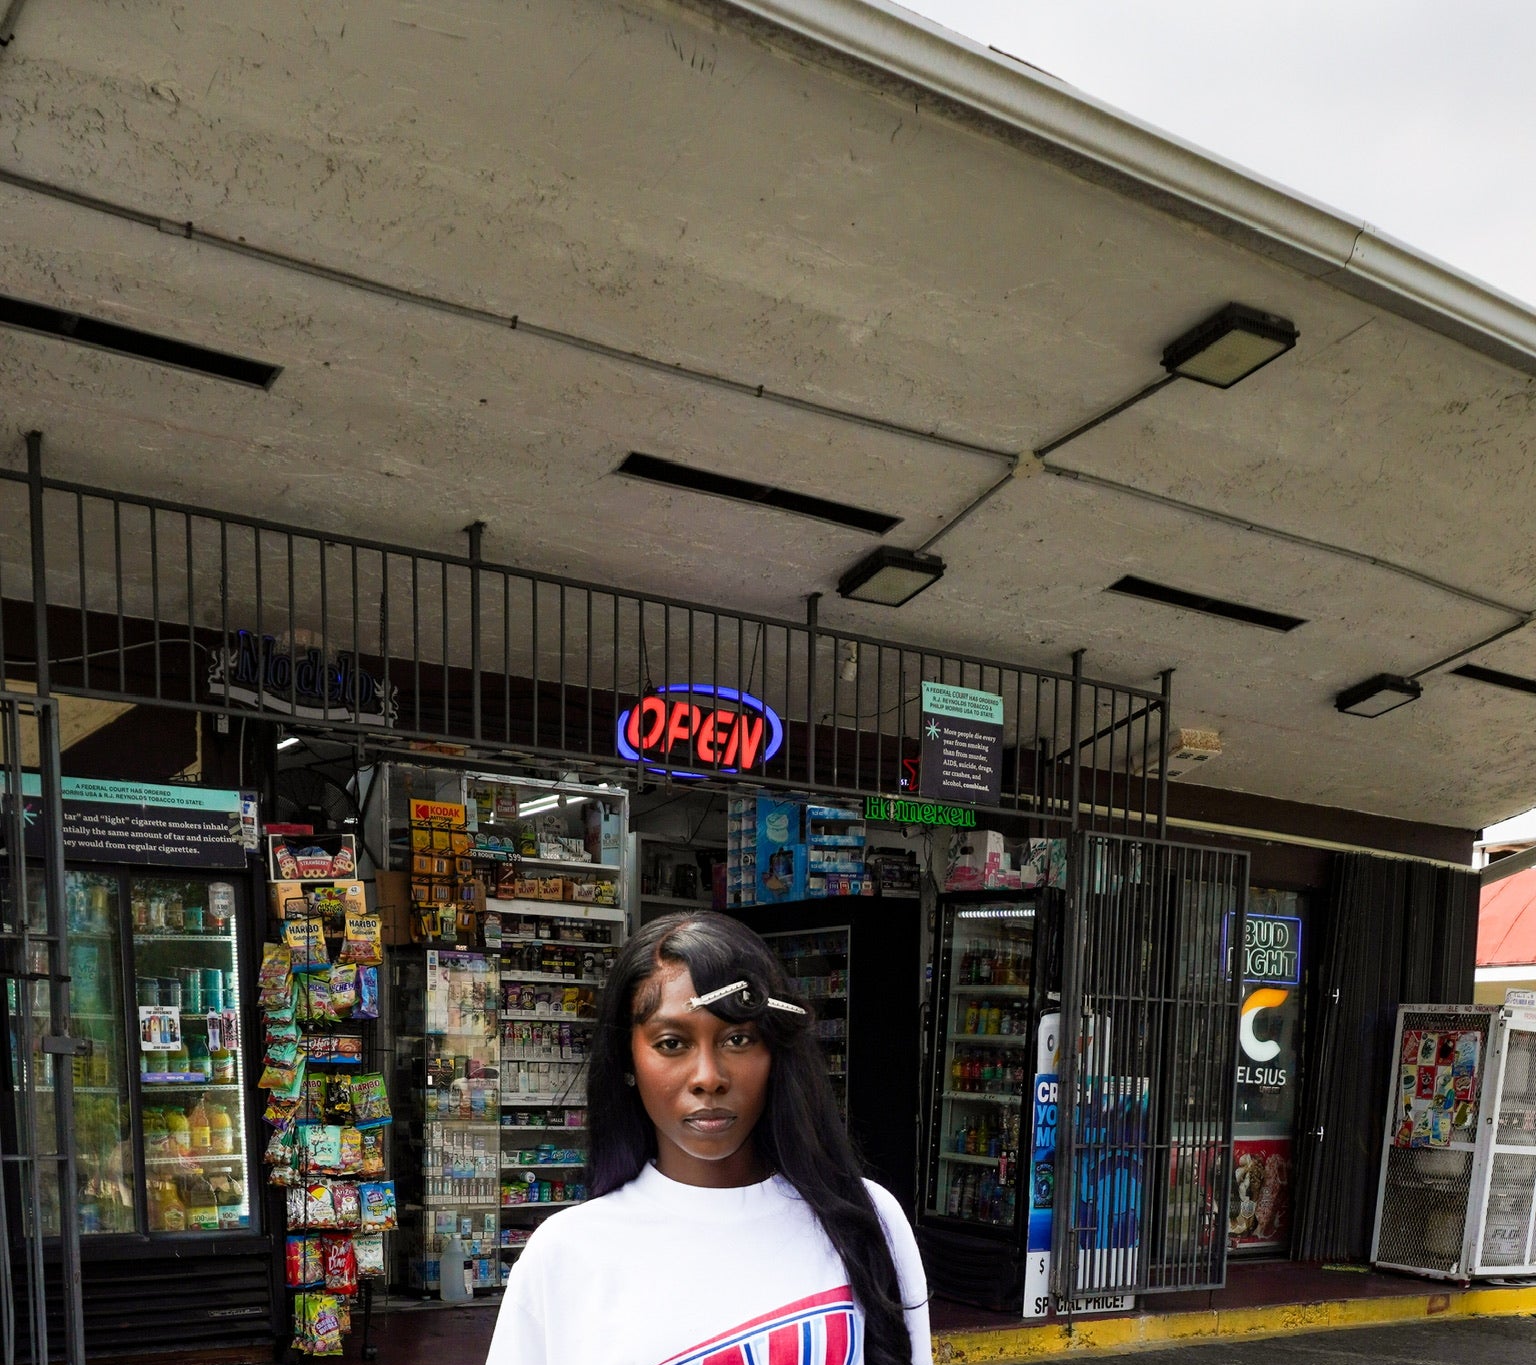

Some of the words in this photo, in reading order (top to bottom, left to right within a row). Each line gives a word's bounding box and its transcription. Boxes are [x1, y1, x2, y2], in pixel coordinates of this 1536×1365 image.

[236, 630, 373, 705] Modelo
[930, 688, 951, 698] FEDERAL
[952, 691, 969, 699] COURT
[979, 697, 999, 706] ORDERED
[943, 698, 967, 706] REYNOLDS
[968, 702, 989, 710] TOBACCO
[930, 702, 944, 710] PHILIP
[945, 705, 963, 714] MORRIS
[628, 696, 763, 769] OPEN
[943, 727, 957, 736] More
[957, 731, 974, 739] people
[983, 735, 997, 744] every
[954, 739, 967, 748] from
[967, 743, 989, 753] smoking
[943, 748, 955, 757] than
[955, 749, 968, 758] from
[968, 753, 988, 762] murder,
[943, 759, 959, 768] AIDS,
[959, 761, 978, 770] suicide,
[978, 764, 994, 774] drugs,
[951, 771, 972, 780] crashes,
[81, 783, 108, 791] FEDERAL
[144, 789, 171, 797] ORDERED
[942, 779, 963, 788] alcohol,
[963, 783, 990, 792] combined.
[149, 796, 176, 804] TOBACCO
[430, 806, 460, 818] KODAK
[865, 796, 977, 828] Heineken
[82, 814, 99, 822] and
[131, 817, 167, 828] cigarette
[168, 820, 202, 830] smokers
[202, 822, 229, 831] inhale
[62, 825, 91, 836] ntially
[92, 826, 106, 836] the
[130, 830, 162, 840] amount
[163, 832, 173, 841] of
[186, 834, 202, 842] and
[78, 839, 104, 848] would
[105, 840, 126, 850] from
[127, 843, 157, 852] regular
[158, 843, 200, 855] cigarettes.
[543, 886, 560, 894] RAW
[349, 919, 377, 928] HARIBO
[1236, 1066, 1287, 1086] ELSIUS
[351, 1079, 380, 1091] HARIBO
[1039, 1257, 1044, 1275] $
[1034, 1297, 1082, 1315] SPCIAL
[1085, 1295, 1124, 1311] PRICE!
